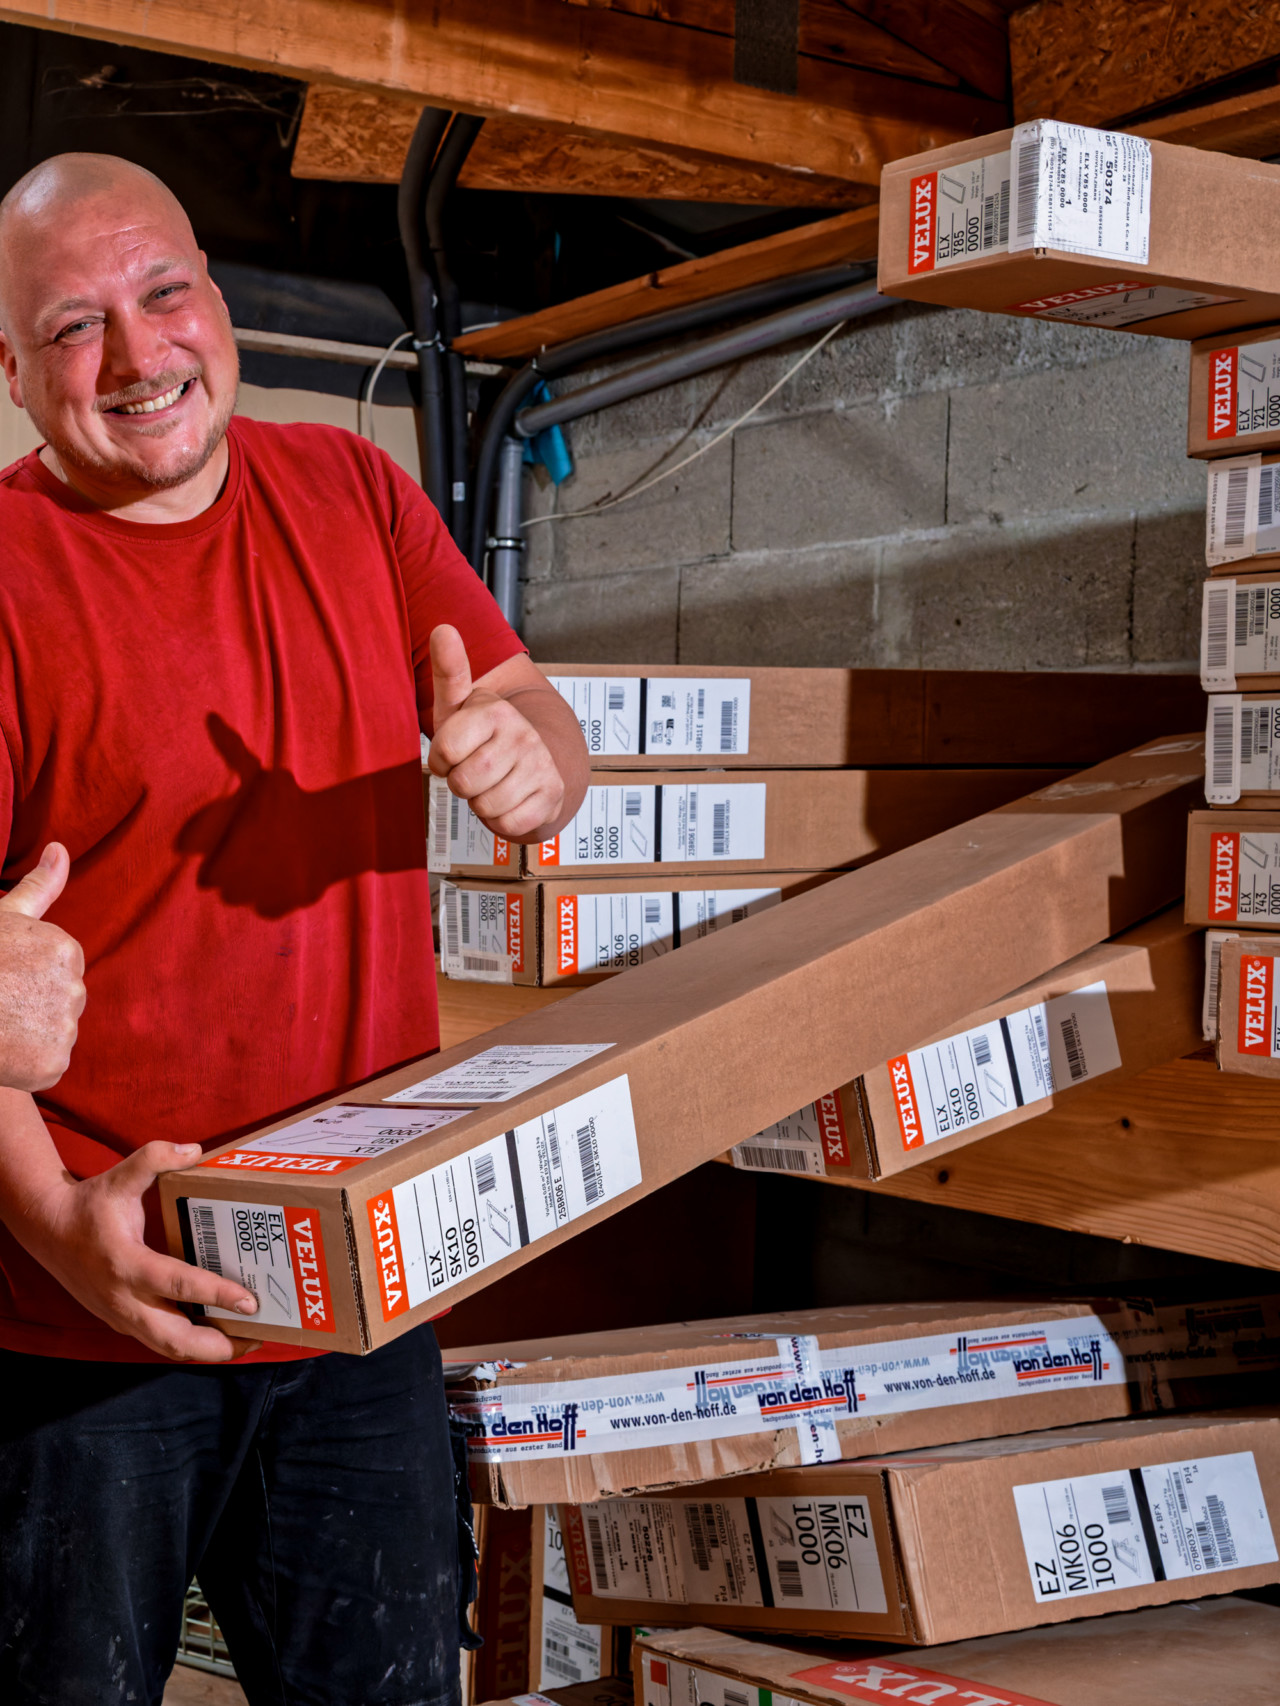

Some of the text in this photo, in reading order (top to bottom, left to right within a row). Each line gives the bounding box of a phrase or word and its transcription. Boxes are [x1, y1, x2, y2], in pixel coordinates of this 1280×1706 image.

[1104, 161, 1114, 205] 50374
[913, 182, 932, 267] VELUX
[967, 216, 980, 252] 0000
[939, 234, 950, 259] ELX
[953, 230, 965, 256] Y85
[1020, 282, 1132, 309] VELUX
[1214, 356, 1232, 433] VELUX
[1269, 395, 1280, 426] 0000
[1238, 409, 1250, 431] ELX
[1253, 406, 1265, 430] Y21
[591, 719, 601, 751] 0000
[578, 836, 589, 859] ELX
[594, 826, 604, 859] SK06
[608, 826, 619, 859] 0000
[1215, 840, 1234, 914] VELUX
[497, 896, 505, 914] ELX
[1240, 892, 1251, 913] ELX
[1256, 892, 1267, 914] Y43
[510, 900, 520, 965] VELUX
[561, 902, 574, 969] VELUX
[629, 934, 639, 966] 0000
[599, 944, 609, 967] ELX
[614, 934, 625, 967] SK06
[1245, 964, 1266, 1047] VELUX
[892, 1064, 918, 1145] VELUX
[936, 1104, 950, 1132] ELX
[950, 1088, 965, 1126] SK10
[964, 1082, 980, 1121] 0000
[371, 1136, 406, 1145] SK10
[378, 1128, 423, 1136] 0000
[219, 1153, 343, 1171] VELUX
[349, 1146, 386, 1154] ELX
[588, 1117, 605, 1198] (240)ELX SK10 0000
[554, 1176, 567, 1220] 25BR06 E
[192, 1207, 202, 1235] (240)ELX
[235, 1210, 253, 1252] 0000
[251, 1211, 269, 1252] SK10
[268, 1213, 284, 1242] ELX
[373, 1202, 403, 1312] VELUX
[445, 1226, 463, 1278] SK10
[463, 1218, 480, 1268] 0000
[293, 1218, 326, 1321] VELUX
[429, 1250, 444, 1287] ELX
[1013, 1340, 1102, 1380] von den Hoff
[757, 1391, 789, 1408] von
[789, 1383, 823, 1402] den
[823, 1370, 858, 1413] Hoff
[884, 1369, 996, 1393] www.von-den-hoff.de
[491, 1404, 578, 1451] den Hoff
[610, 1402, 737, 1429] www.von-den-hoff.de
[521, 1443, 544, 1452] erster
[843, 1504, 868, 1539] EZ
[1153, 1503, 1163, 1522] BFX
[792, 1503, 821, 1566] 1000
[818, 1504, 848, 1569] MK06
[1160, 1532, 1169, 1545] EZ
[1185, 1527, 1202, 1571] 07BR03V
[746, 1555, 756, 1573] BFX
[1056, 1524, 1089, 1591] MK06
[1084, 1523, 1116, 1587] 1000
[1034, 1559, 1061, 1596] EZ
